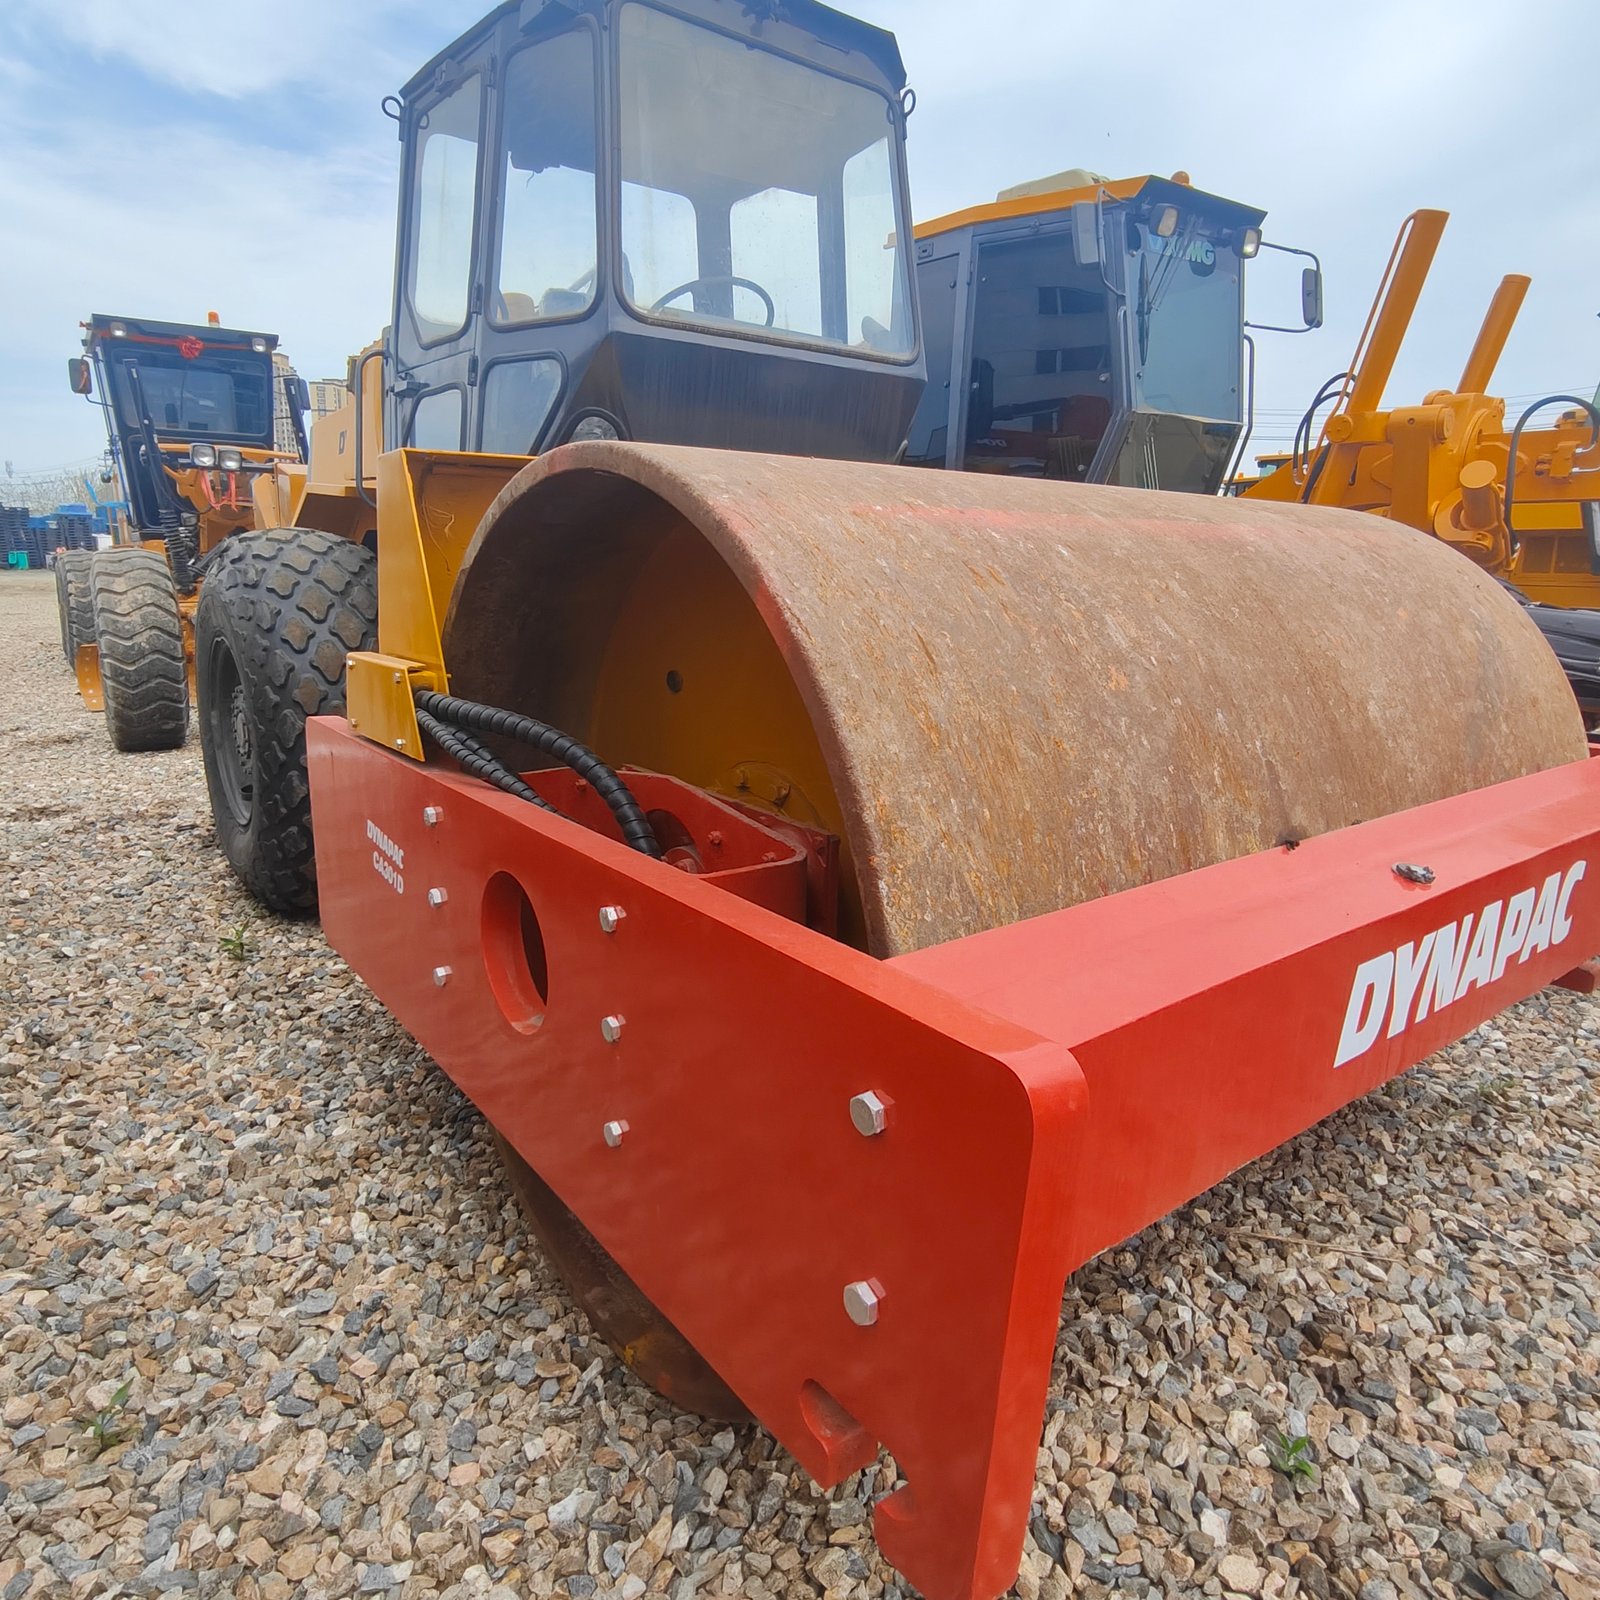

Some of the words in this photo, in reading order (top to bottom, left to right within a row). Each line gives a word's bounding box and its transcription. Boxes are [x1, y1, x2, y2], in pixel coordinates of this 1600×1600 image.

[367, 819, 404, 869] DYNAPAC
[373, 851, 404, 894] CA301D
[1333, 860, 1587, 1068] DYNAPAC
